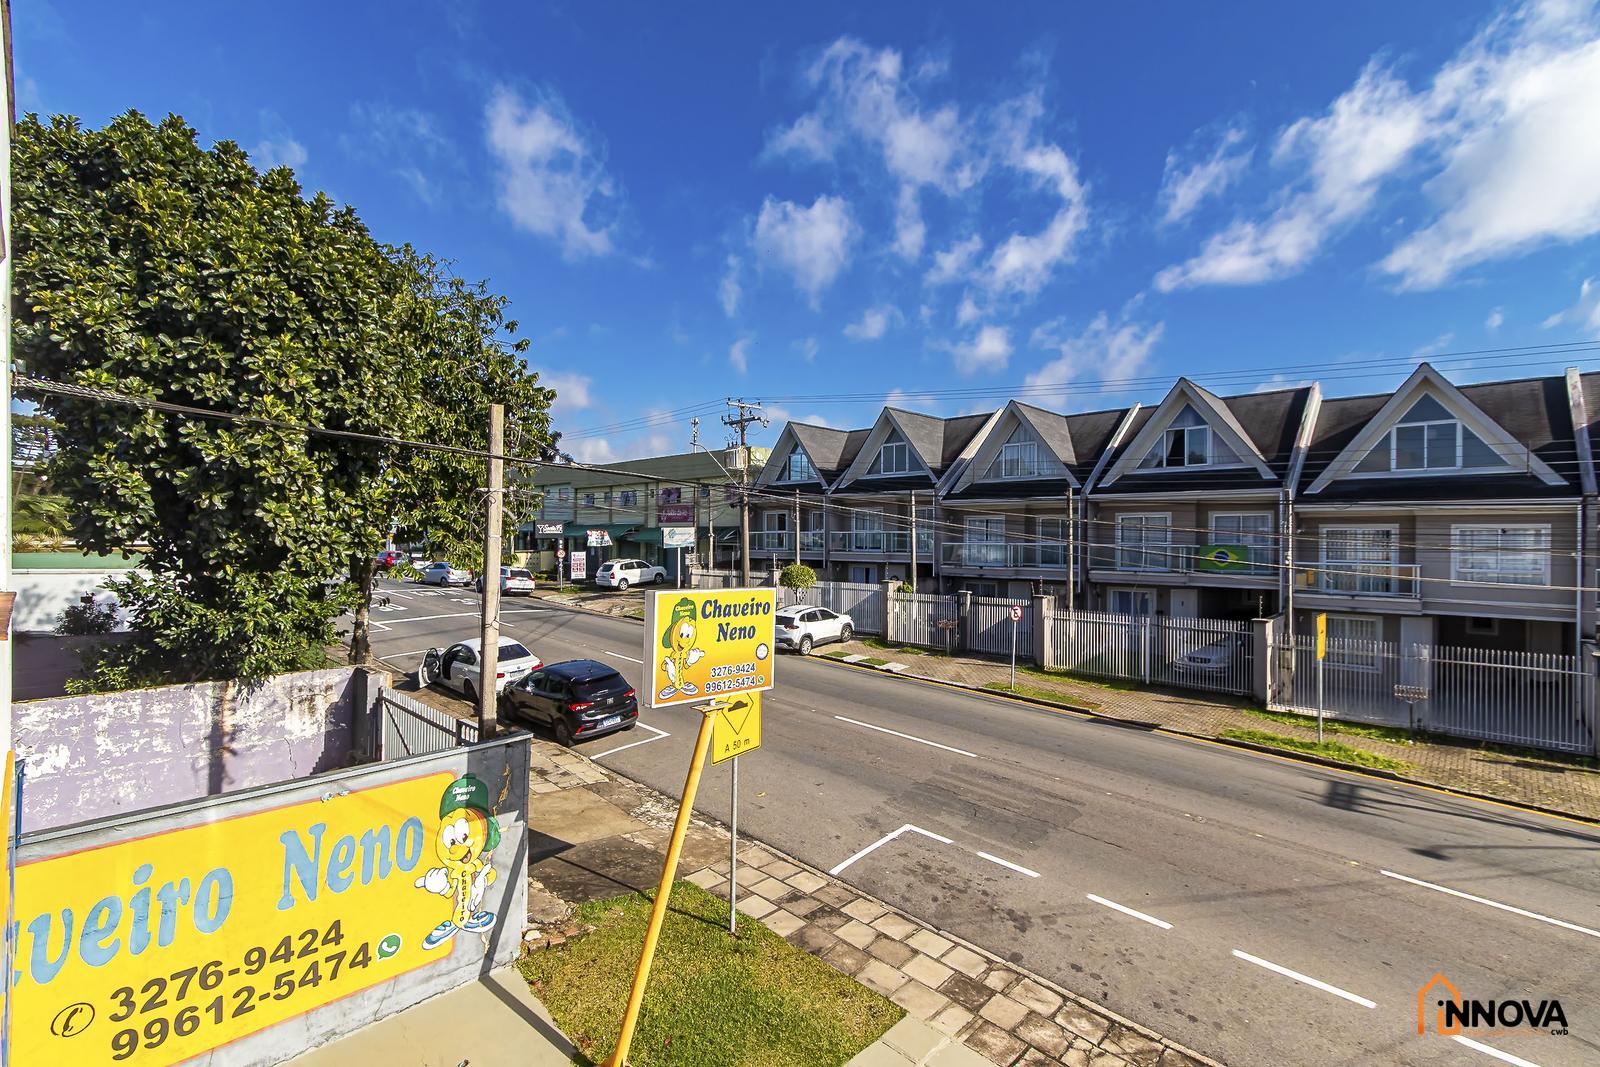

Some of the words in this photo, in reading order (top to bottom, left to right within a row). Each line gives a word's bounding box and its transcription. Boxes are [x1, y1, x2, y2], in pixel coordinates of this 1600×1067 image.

[701, 598, 771, 619] Chaveiro
[716, 622, 756, 642] Neno
[711, 663, 756, 678] 3276-9424
[705, 676, 756, 693] 99612-5474
[725, 744, 730, 753] A
[744, 738, 750, 746] m
[276, 816, 424, 911] Neno
[109, 919, 344, 1022] 3276-9424
[111, 942, 372, 1061] 99612-5474
